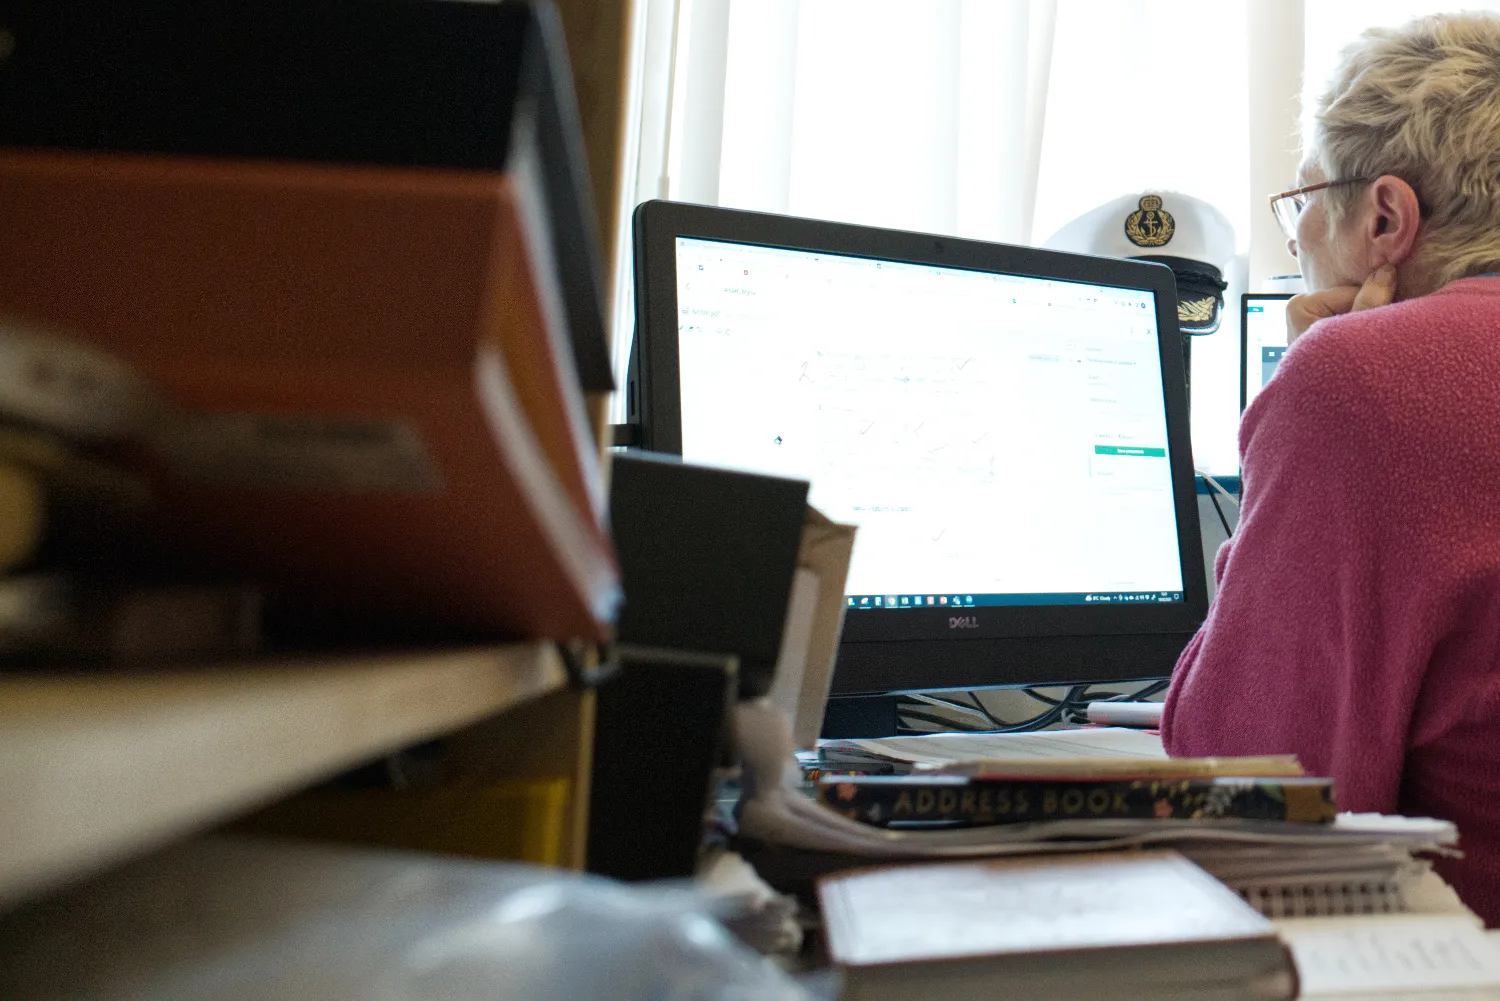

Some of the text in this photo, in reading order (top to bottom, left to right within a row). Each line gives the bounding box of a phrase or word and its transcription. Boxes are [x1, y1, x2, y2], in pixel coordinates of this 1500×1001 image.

[948, 616, 979, 629] DELL
[893, 787, 1131, 816] ADDRESS BOOK
